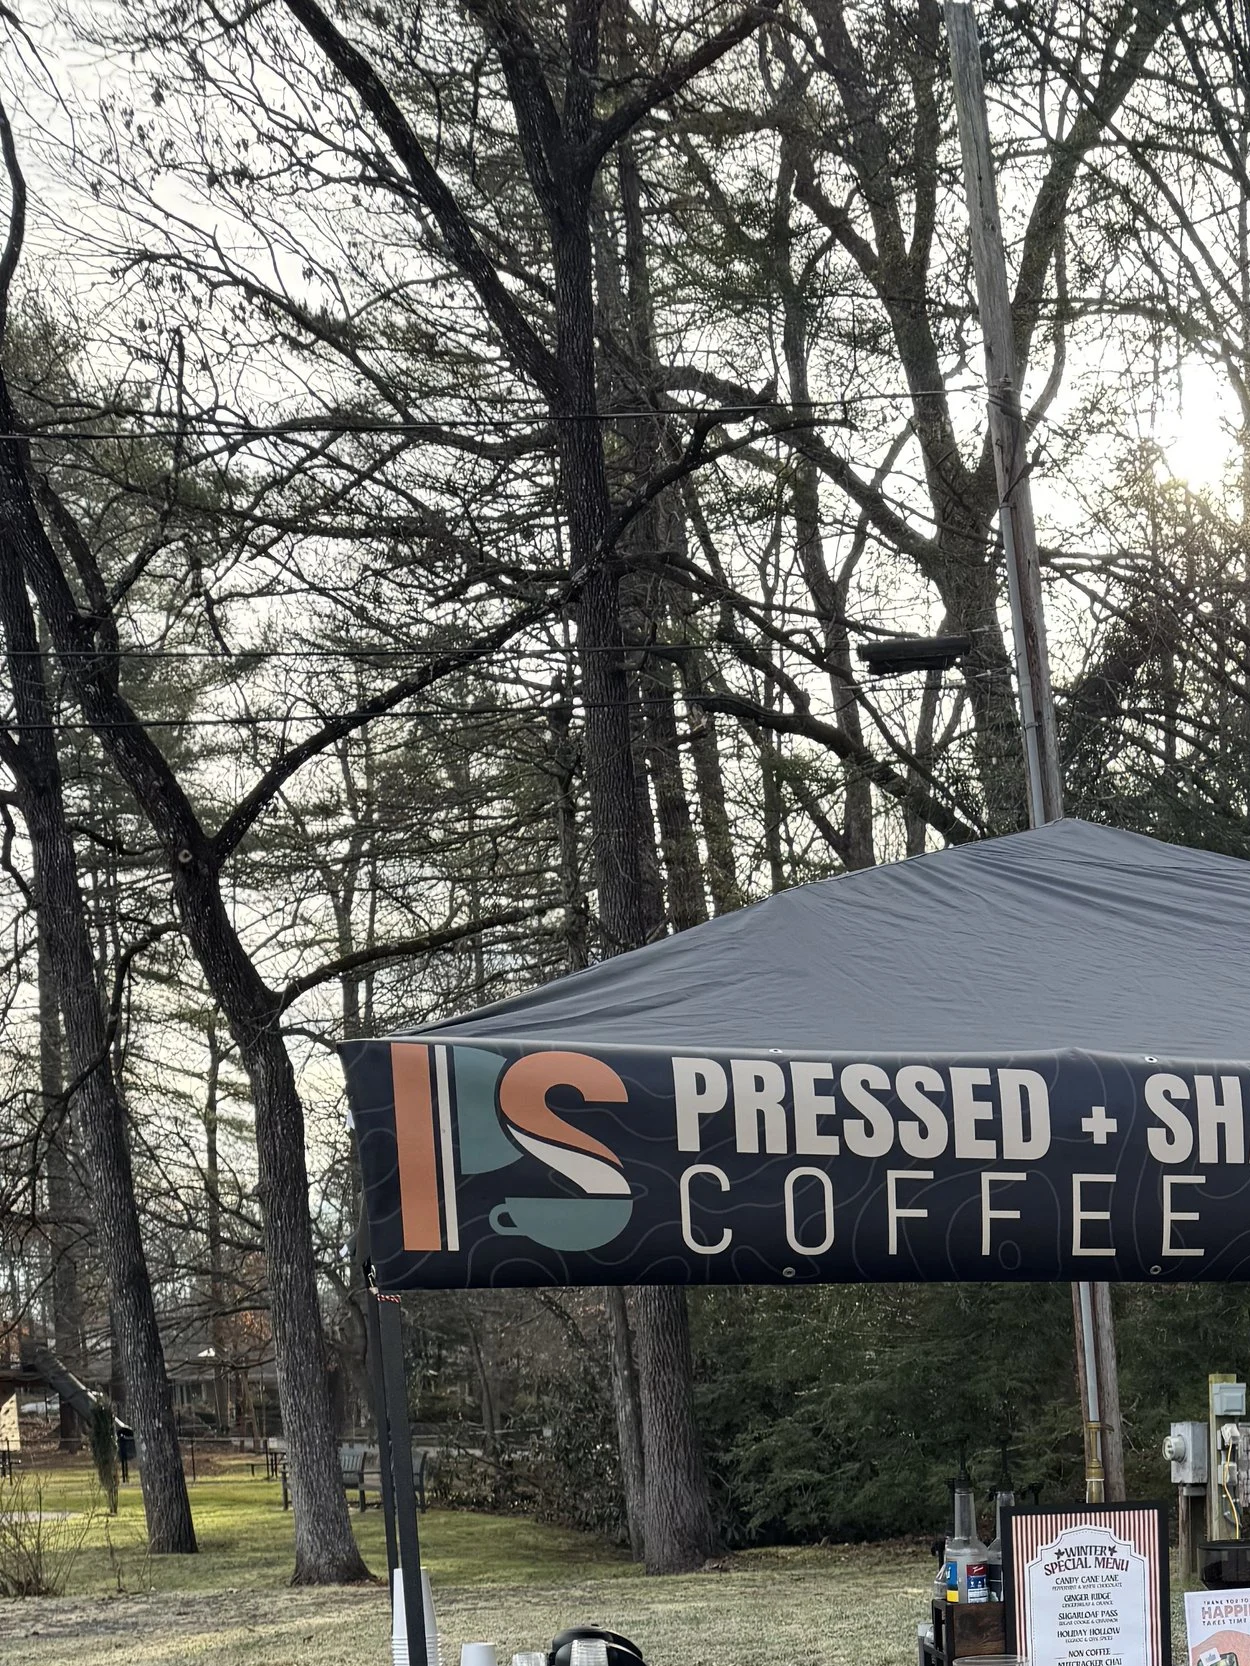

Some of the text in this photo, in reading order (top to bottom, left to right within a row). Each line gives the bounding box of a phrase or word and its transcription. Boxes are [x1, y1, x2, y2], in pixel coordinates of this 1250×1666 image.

[671, 1056, 1051, 1162] PRESSED
[680, 1162, 1207, 1257] COFFEE
[1064, 1545, 1107, 1558] WINTER
[1043, 1557, 1129, 1576] SPECIAL MENU
[1055, 1574, 1119, 1585] CANDY CANE LANE
[1064, 1592, 1111, 1602] GINGER RIDGE
[1058, 1609, 1118, 1620] SUGARLOAF PASS
[1057, 1627, 1120, 1638] HOLIDAY HOLLOW
[1068, 1648, 1111, 1657] NON COFFEE
[1105, 1658, 1122, 1666] CHAI
